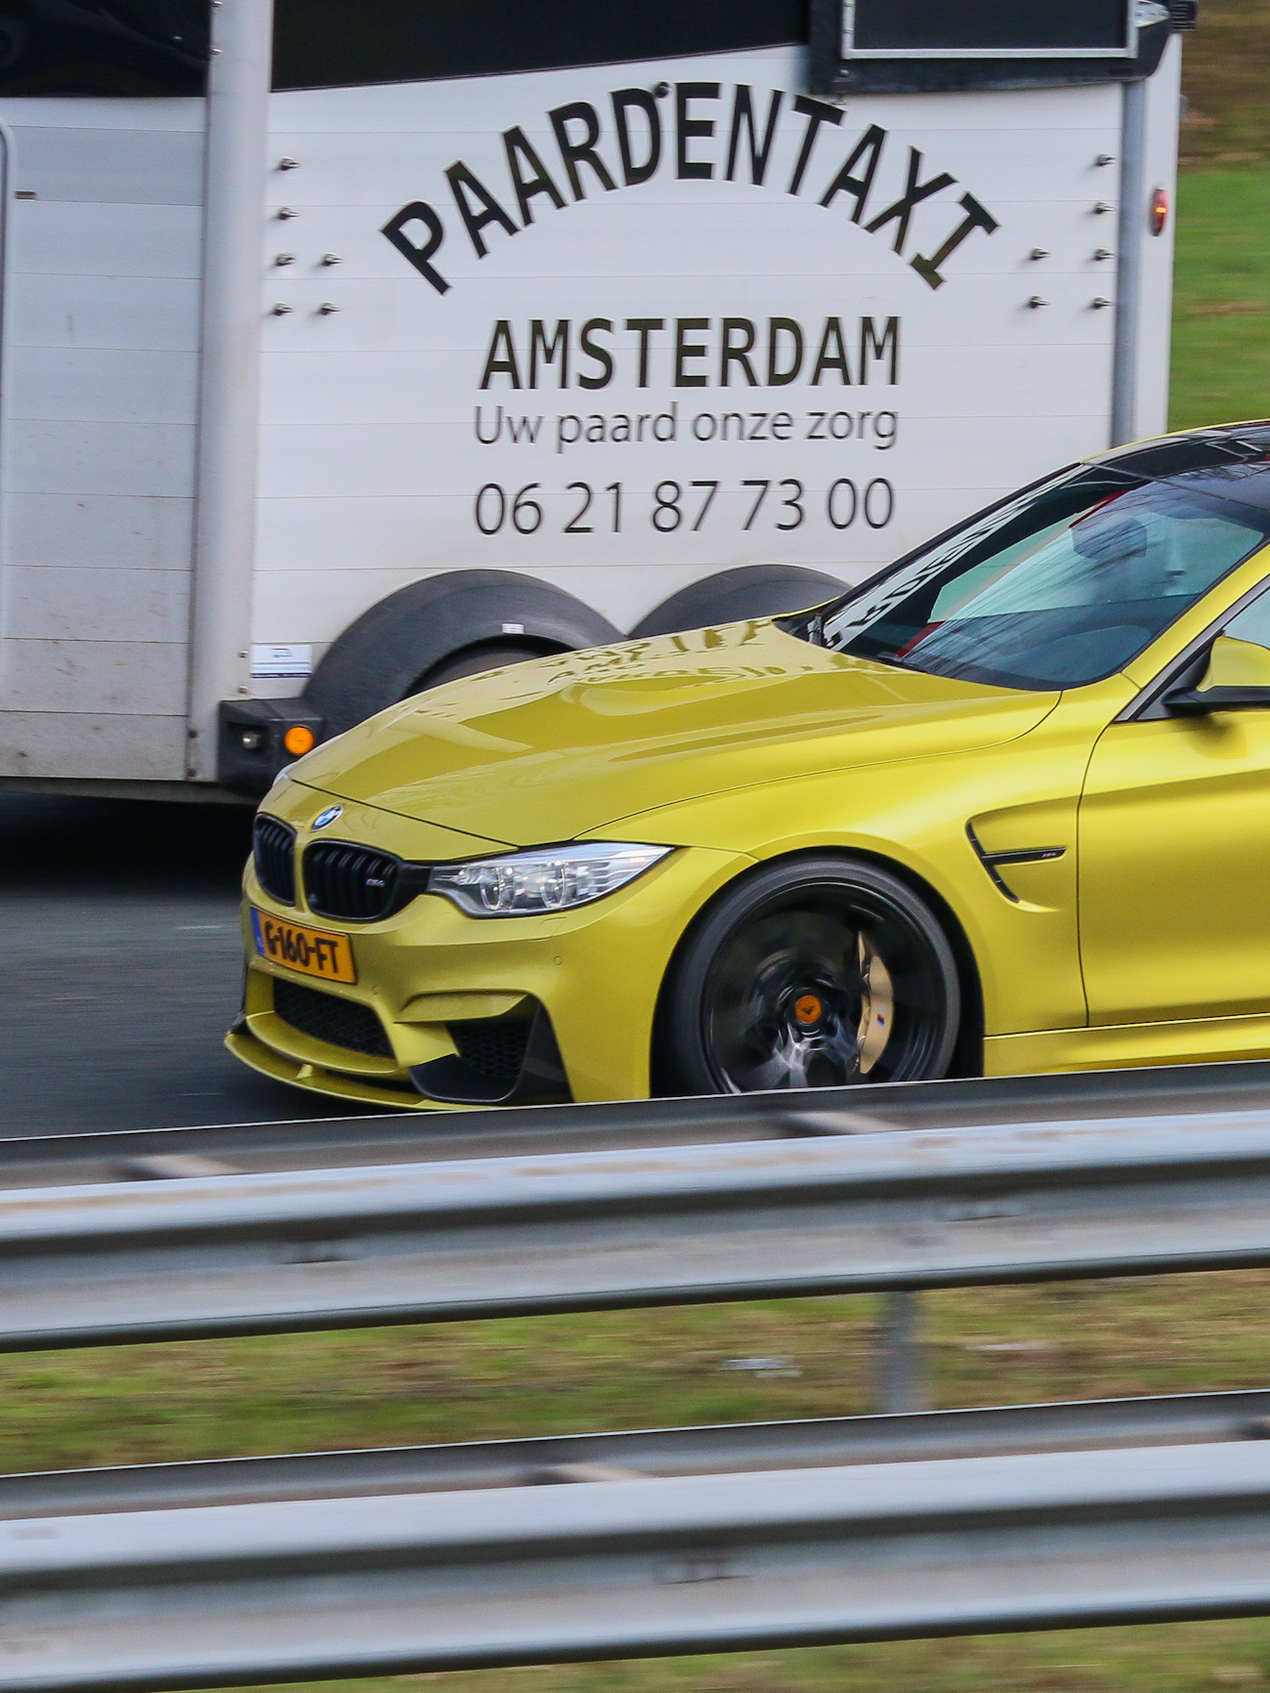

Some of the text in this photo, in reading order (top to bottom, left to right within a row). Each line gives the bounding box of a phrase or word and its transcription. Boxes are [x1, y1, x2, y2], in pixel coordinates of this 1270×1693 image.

[379, 81, 1002, 296] PAARDENTAXI
[479, 316, 901, 390] AMSTERDAM
[474, 401, 899, 454] Uw paard onze zorg
[474, 477, 896, 536] 06 21 87 73 00
[264, 920, 339, 974] G-160-FT
